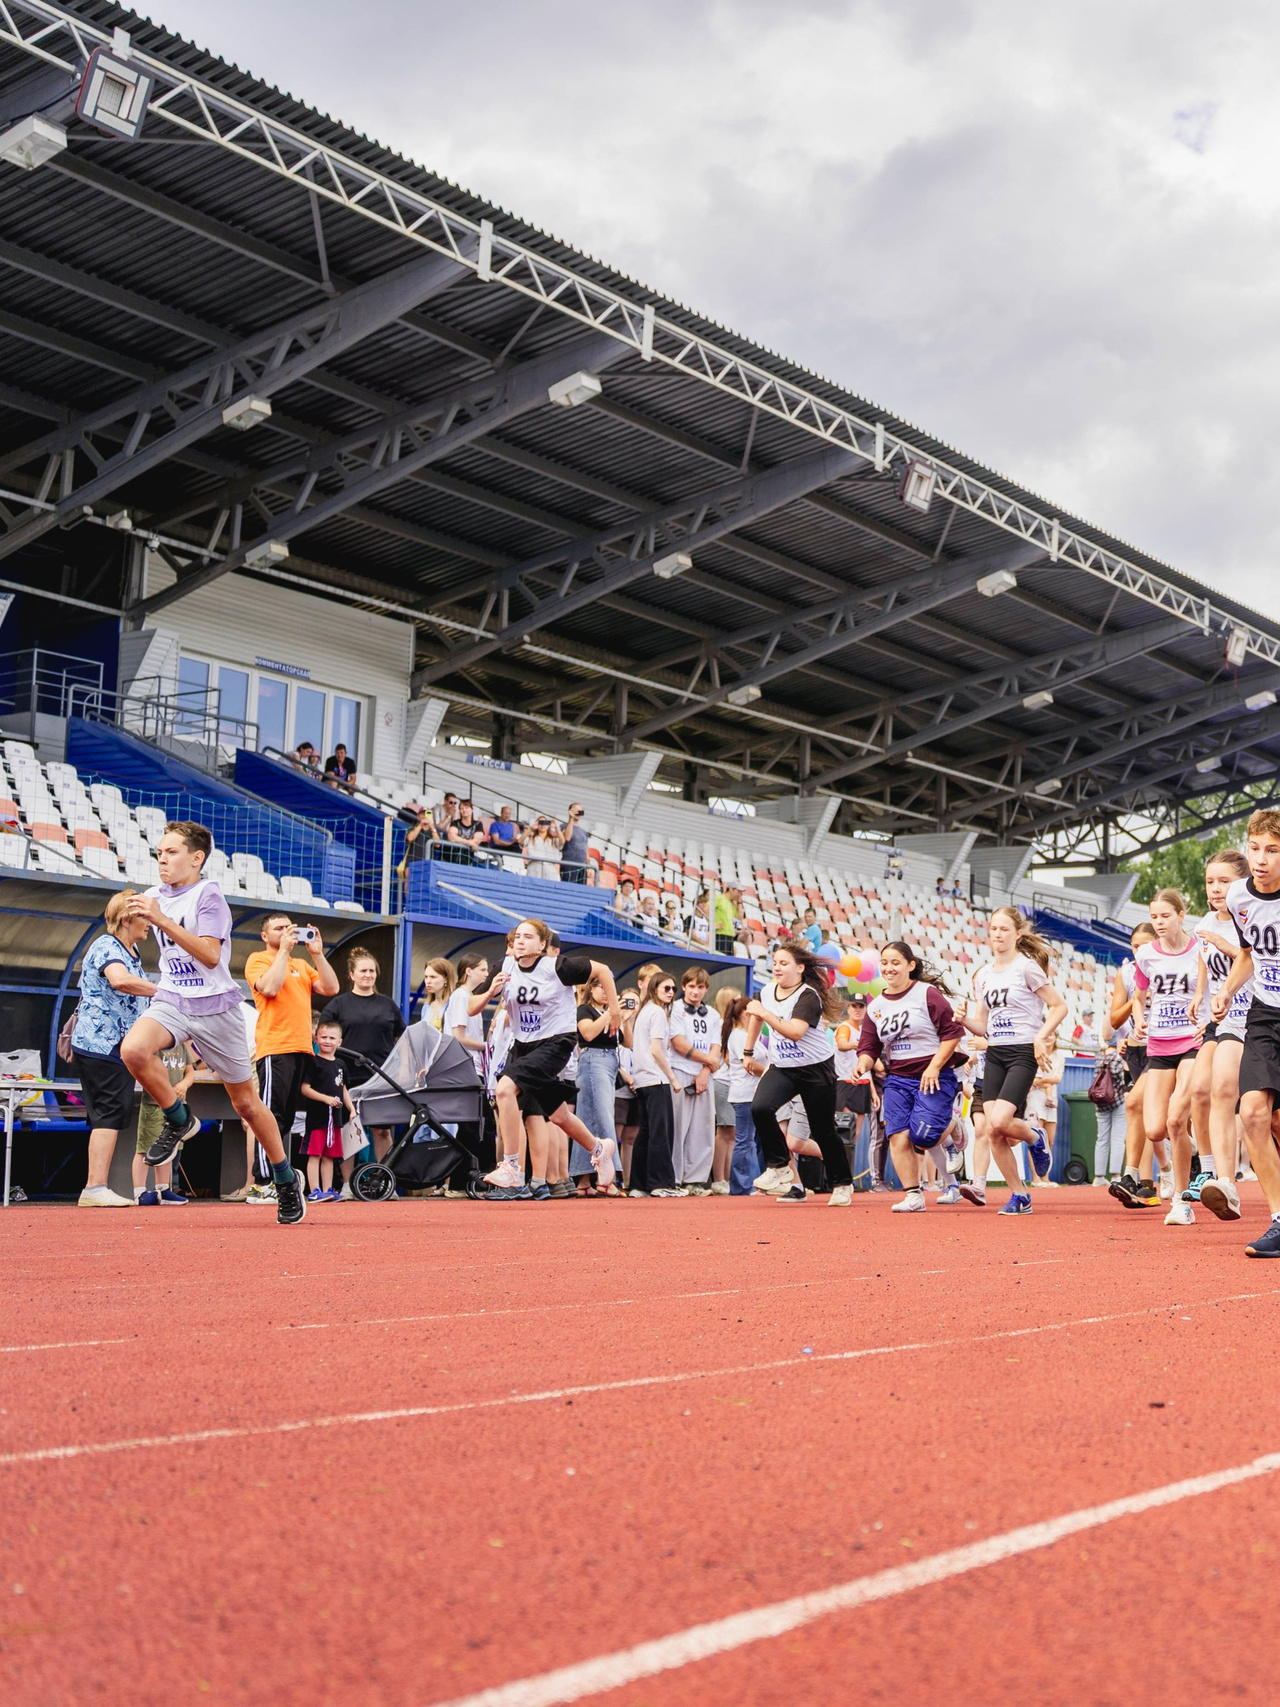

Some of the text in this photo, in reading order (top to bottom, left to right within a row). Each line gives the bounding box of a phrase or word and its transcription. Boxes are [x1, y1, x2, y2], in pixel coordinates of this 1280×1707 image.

[473, 754, 505, 770] ПРЕССА
[1154, 973, 1189, 995] 271
[516, 986, 541, 1005] 82
[984, 988, 1009, 1009] 127
[693, 1019, 708, 1034] 99
[881, 1010, 911, 1036] 252
